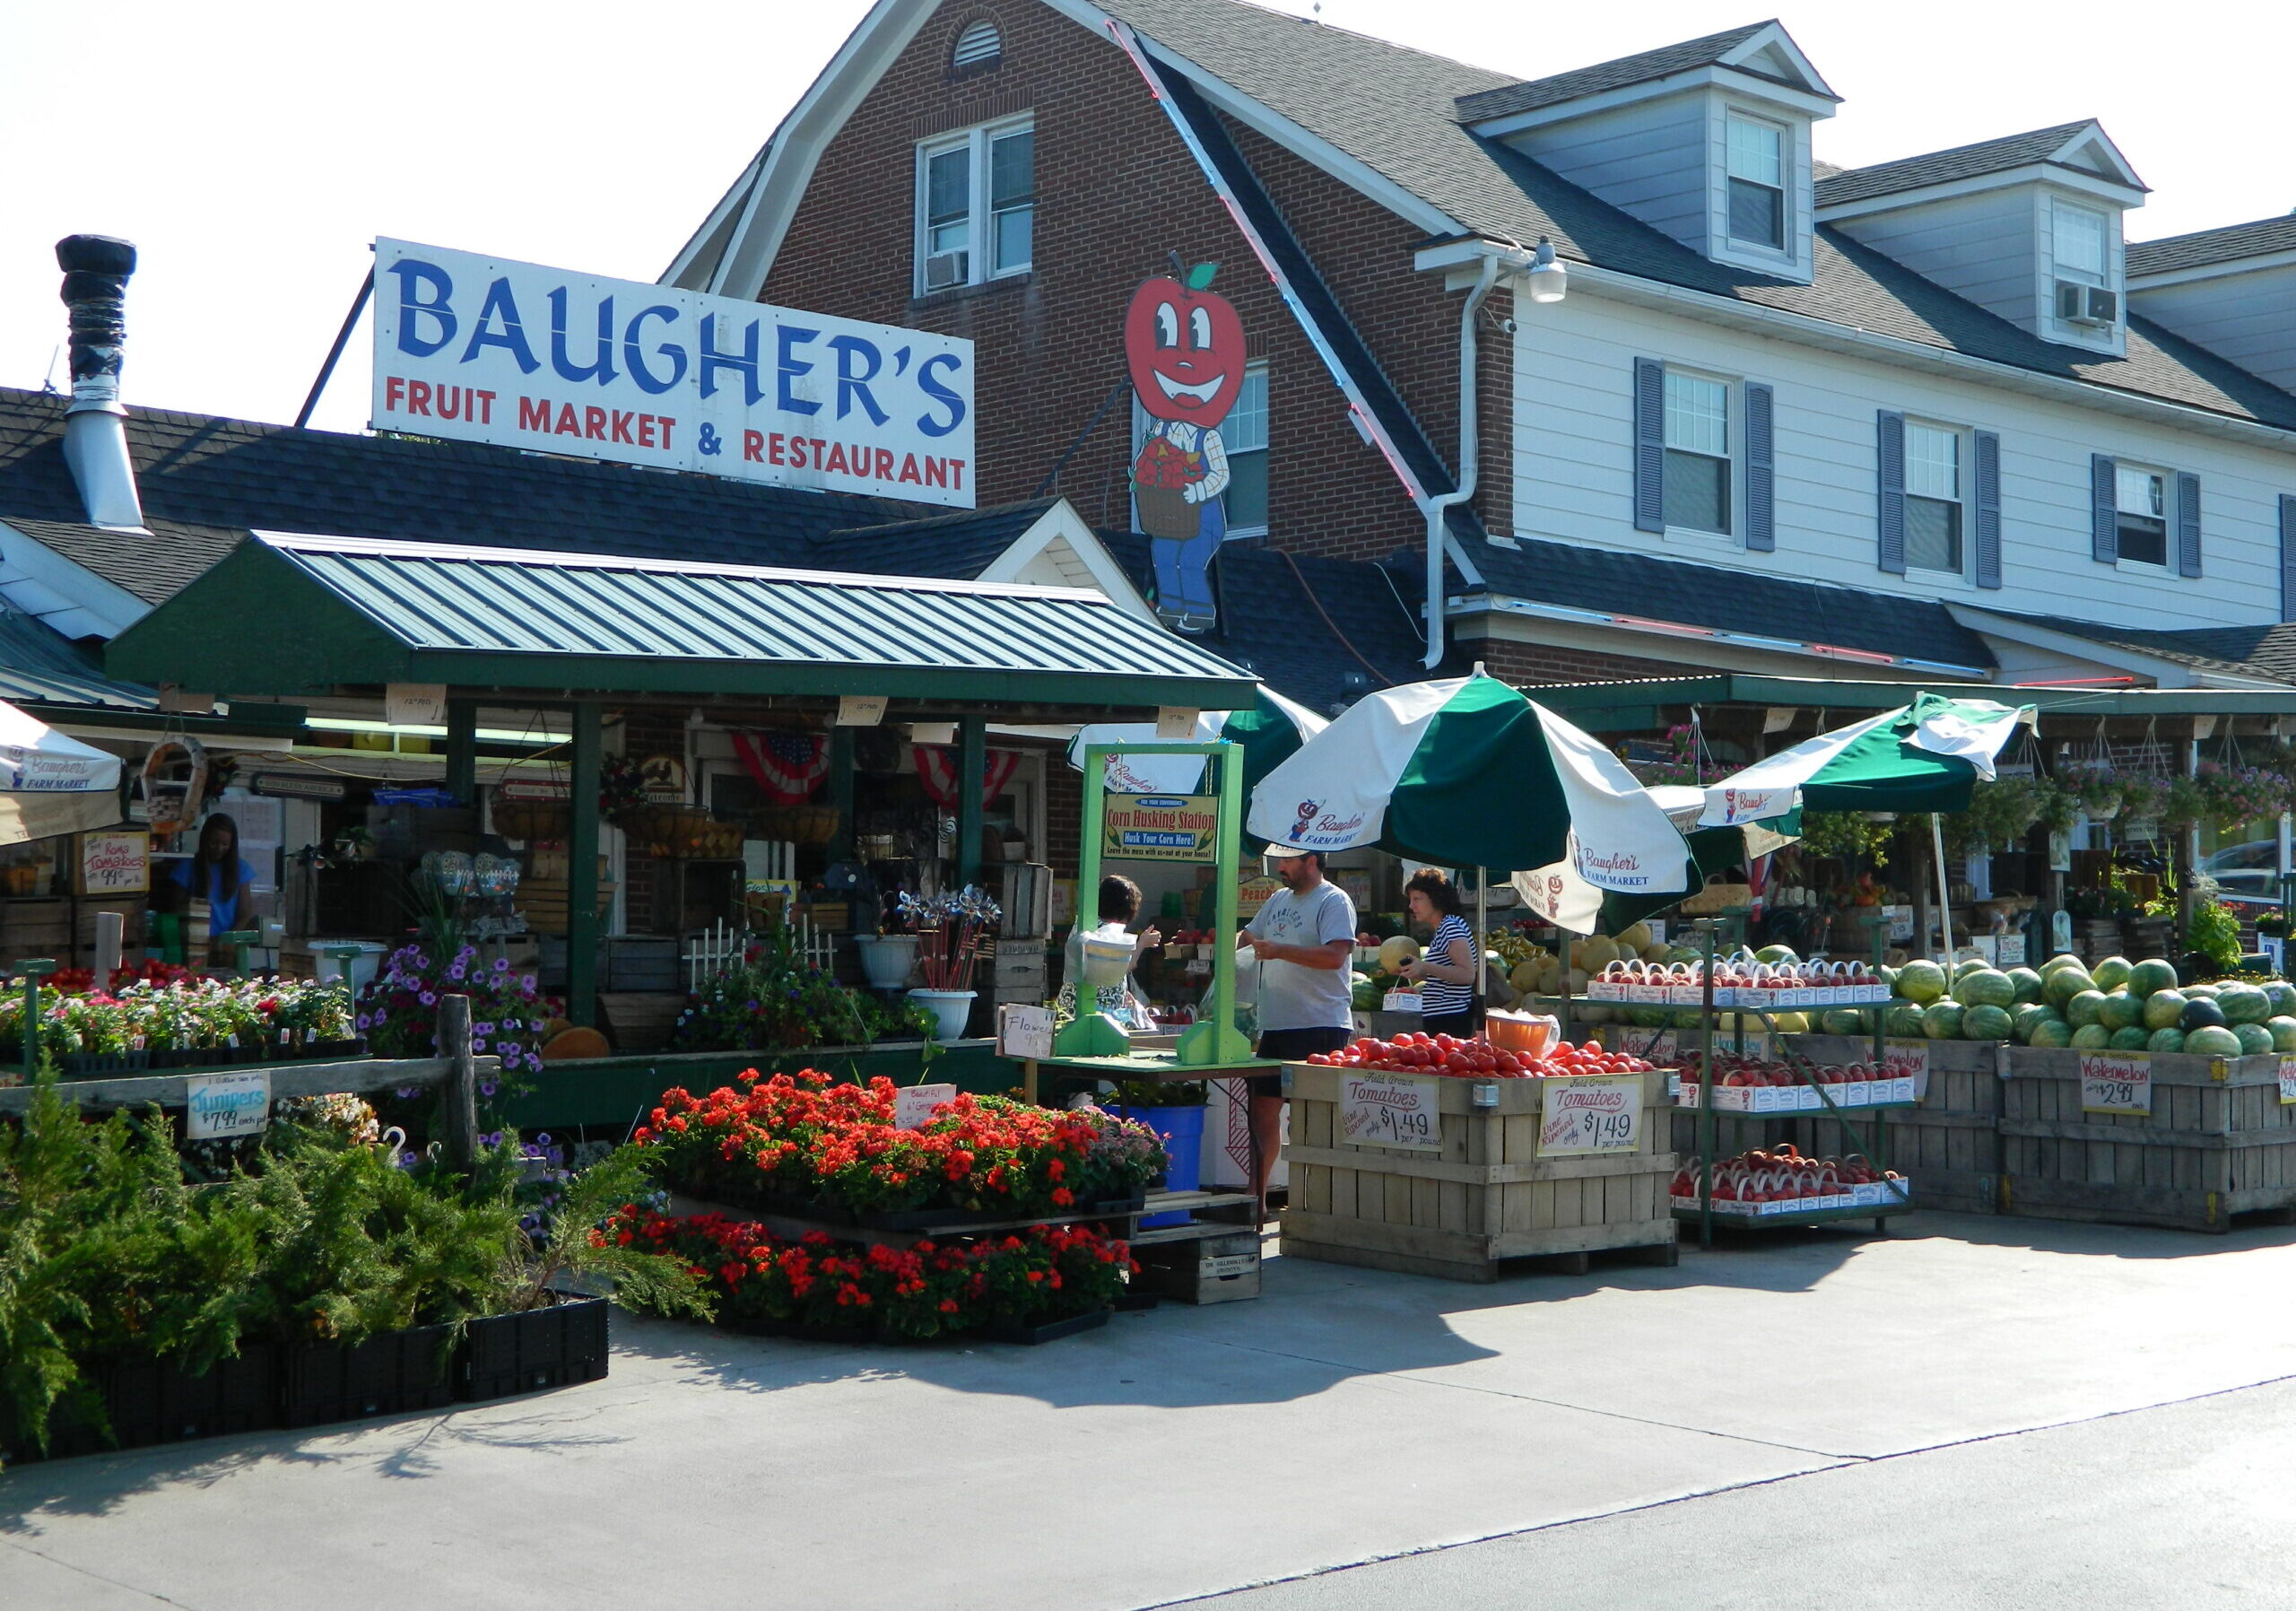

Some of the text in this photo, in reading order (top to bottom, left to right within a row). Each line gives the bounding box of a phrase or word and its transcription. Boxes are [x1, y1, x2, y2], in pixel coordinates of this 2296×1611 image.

[387, 258, 966, 438] BAUGHER'S
[386, 376, 966, 491] FRUIT MARKET & RESTAURANT
[27, 779, 90, 789] FARM MARKET
[1107, 809, 1215, 831] Corn Husking Station
[1125, 832, 1195, 846] Husk Your Corn Here!
[1305, 833, 1333, 845] FARM
[1107, 846, 1121, 855] Leave
[1146, 847, 1156, 856] with
[1182, 849, 1194, 858] your
[1195, 849, 1211, 858] house!
[1584, 848, 1639, 874] Baugher's
[1587, 872, 1649, 885] FARM MARKET
[189, 1087, 266, 1113] Junipers
[1349, 1081, 1418, 1106] Tomatoes
[1555, 1090, 1622, 1107] Tomatoes
[203, 1111, 238, 1132] $7.99
[1366, 1106, 1428, 1141] only $1.49
[1563, 1111, 1631, 1147] only $1.49
[1401, 1135, 1441, 1146] per pound
[1602, 1138, 1636, 1151] per pound
